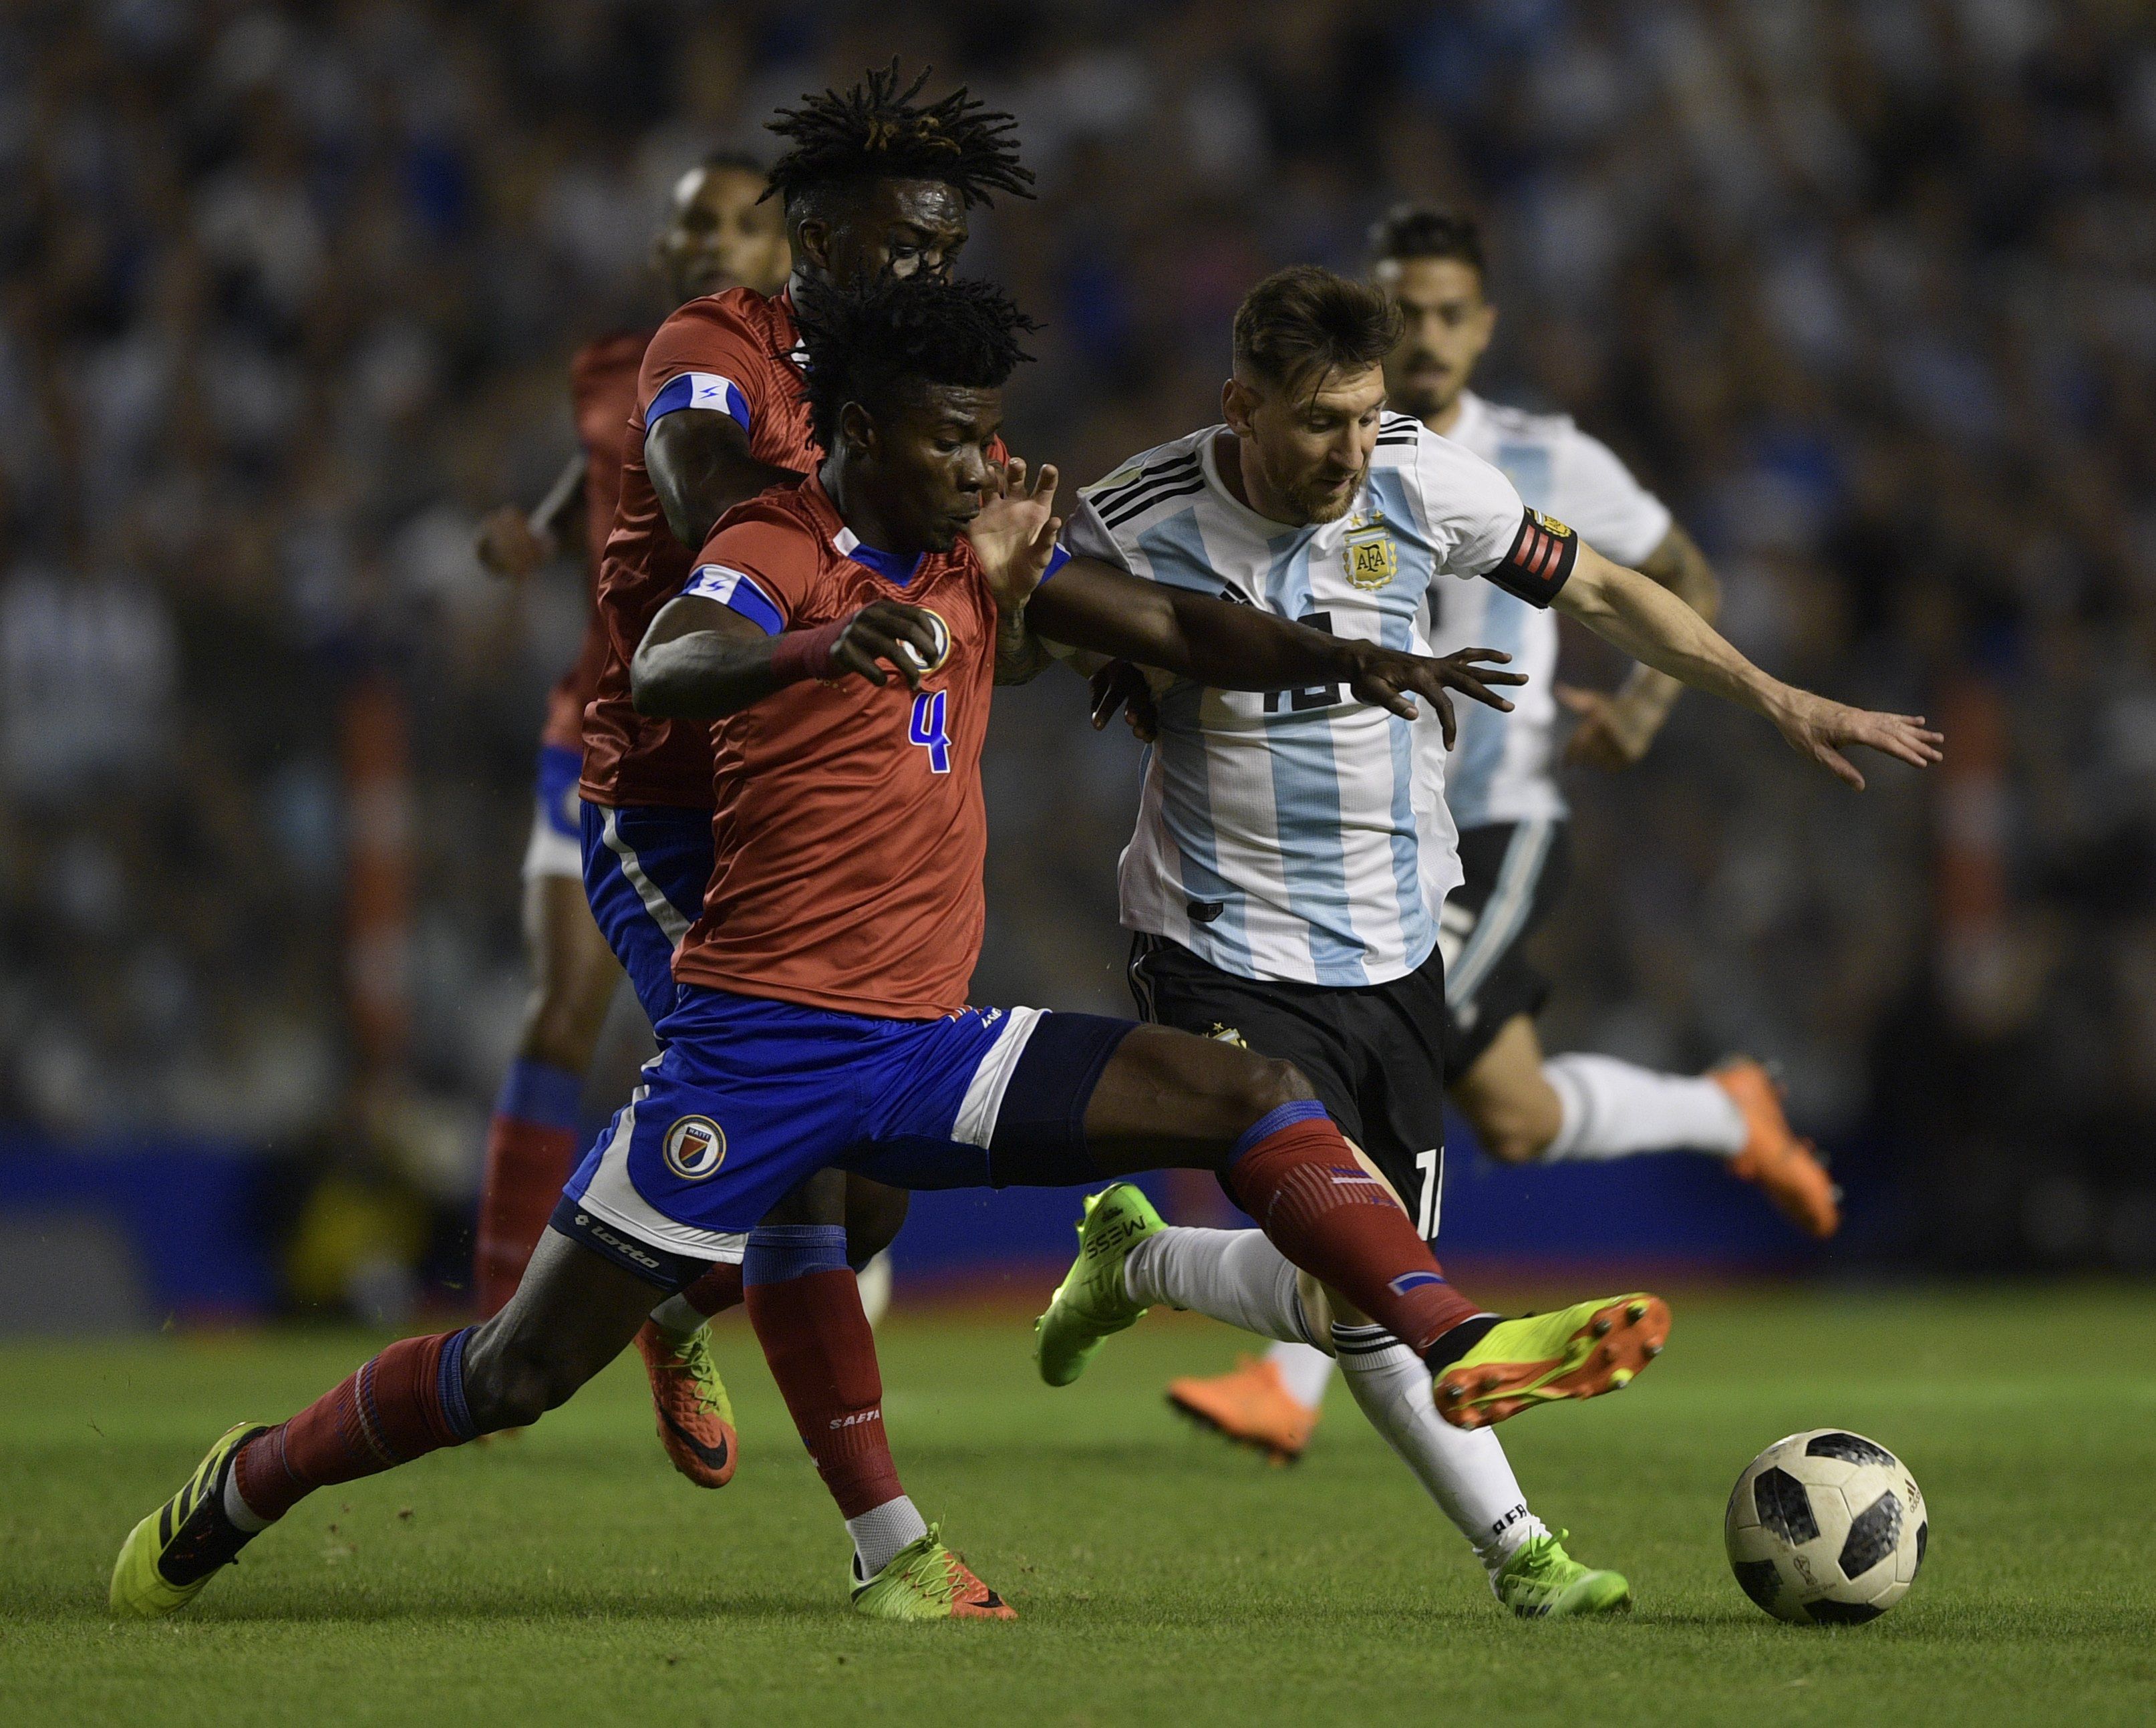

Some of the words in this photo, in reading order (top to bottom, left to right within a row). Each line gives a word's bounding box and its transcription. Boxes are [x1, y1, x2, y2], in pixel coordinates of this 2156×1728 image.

[1357, 544, 1386, 573] AFA
[908, 689, 952, 774] 4
[1415, 1146, 1444, 1242] 1
[829, 1409, 881, 1430] SAETA
